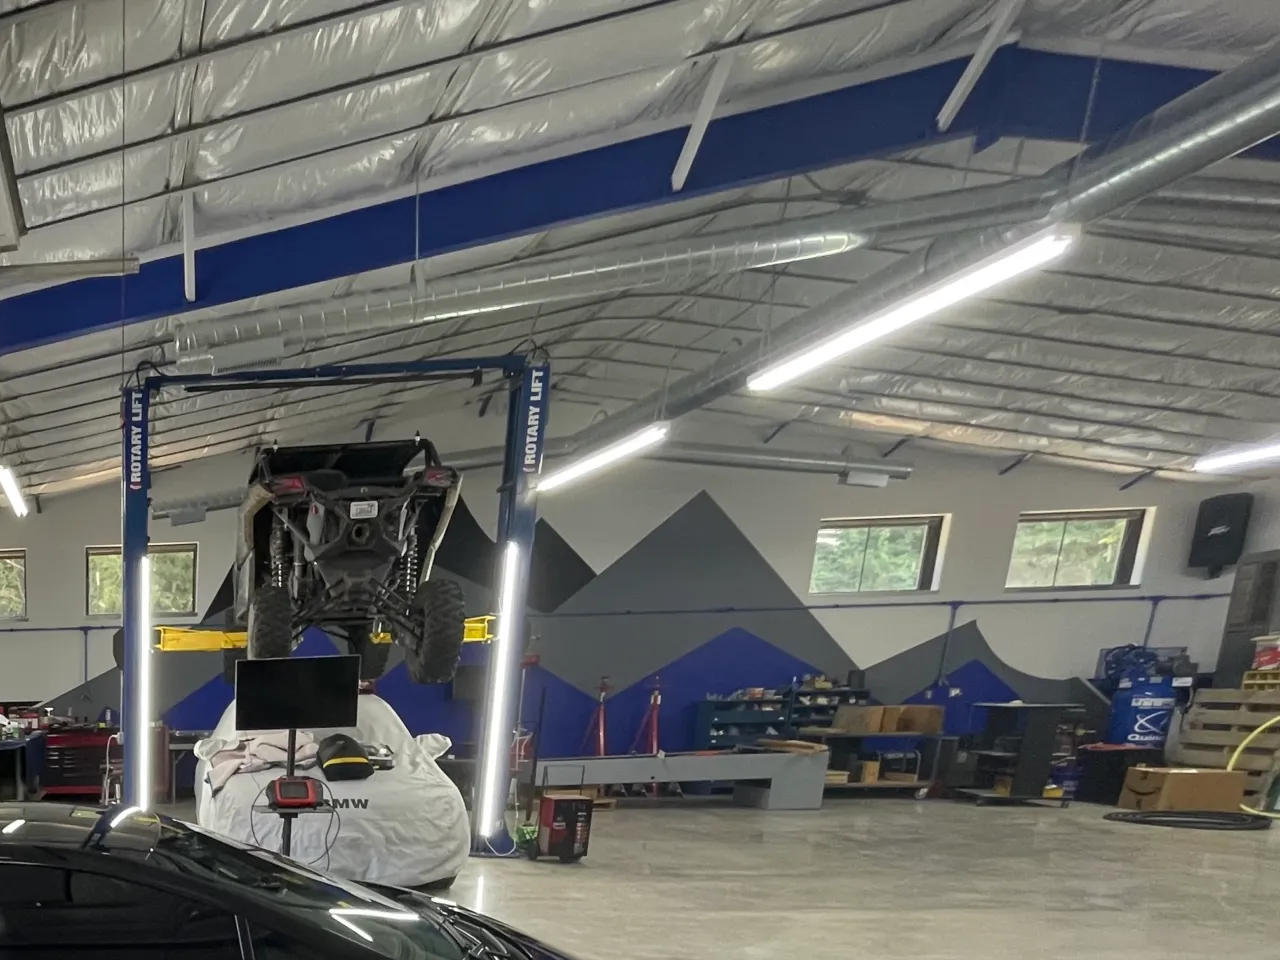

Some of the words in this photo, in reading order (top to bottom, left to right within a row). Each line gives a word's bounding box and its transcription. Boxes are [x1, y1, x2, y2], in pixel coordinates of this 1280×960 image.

[131, 391, 143, 422] LIFT
[529, 369, 544, 402] LIFT
[130, 425, 142, 483] ROTARY
[524, 405, 541, 465] ROTARY
